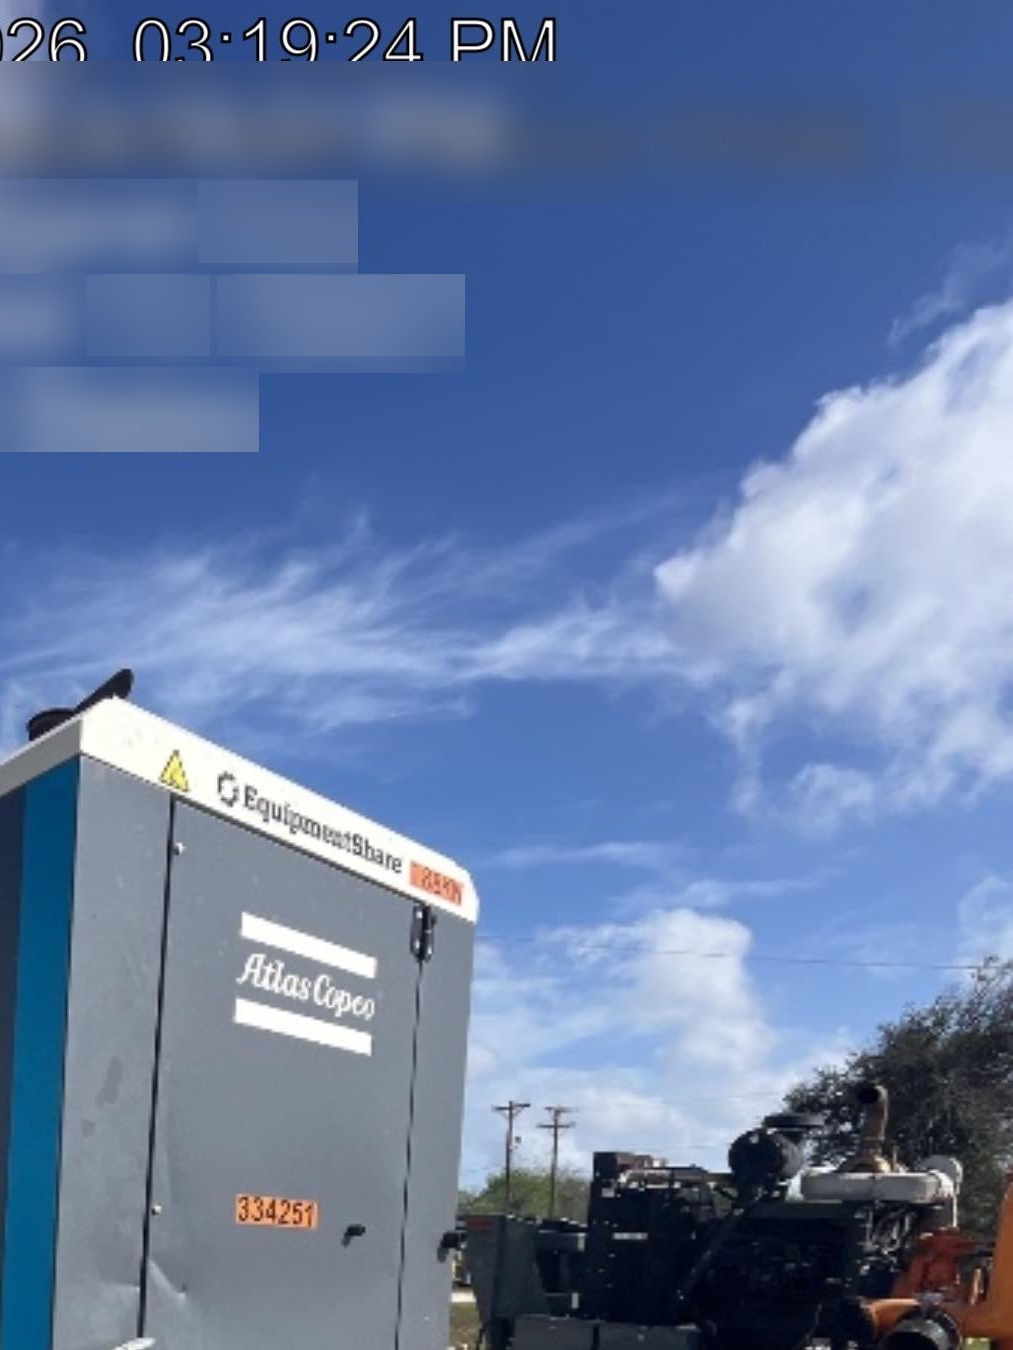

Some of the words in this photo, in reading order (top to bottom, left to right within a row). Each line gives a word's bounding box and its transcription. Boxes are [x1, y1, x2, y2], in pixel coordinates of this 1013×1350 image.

[244, 785, 403, 873] EquipmentShare
[236, 953, 312, 1001] Atlas
[313, 974, 376, 1020] Copco
[238, 1196, 313, 1229] 334251
